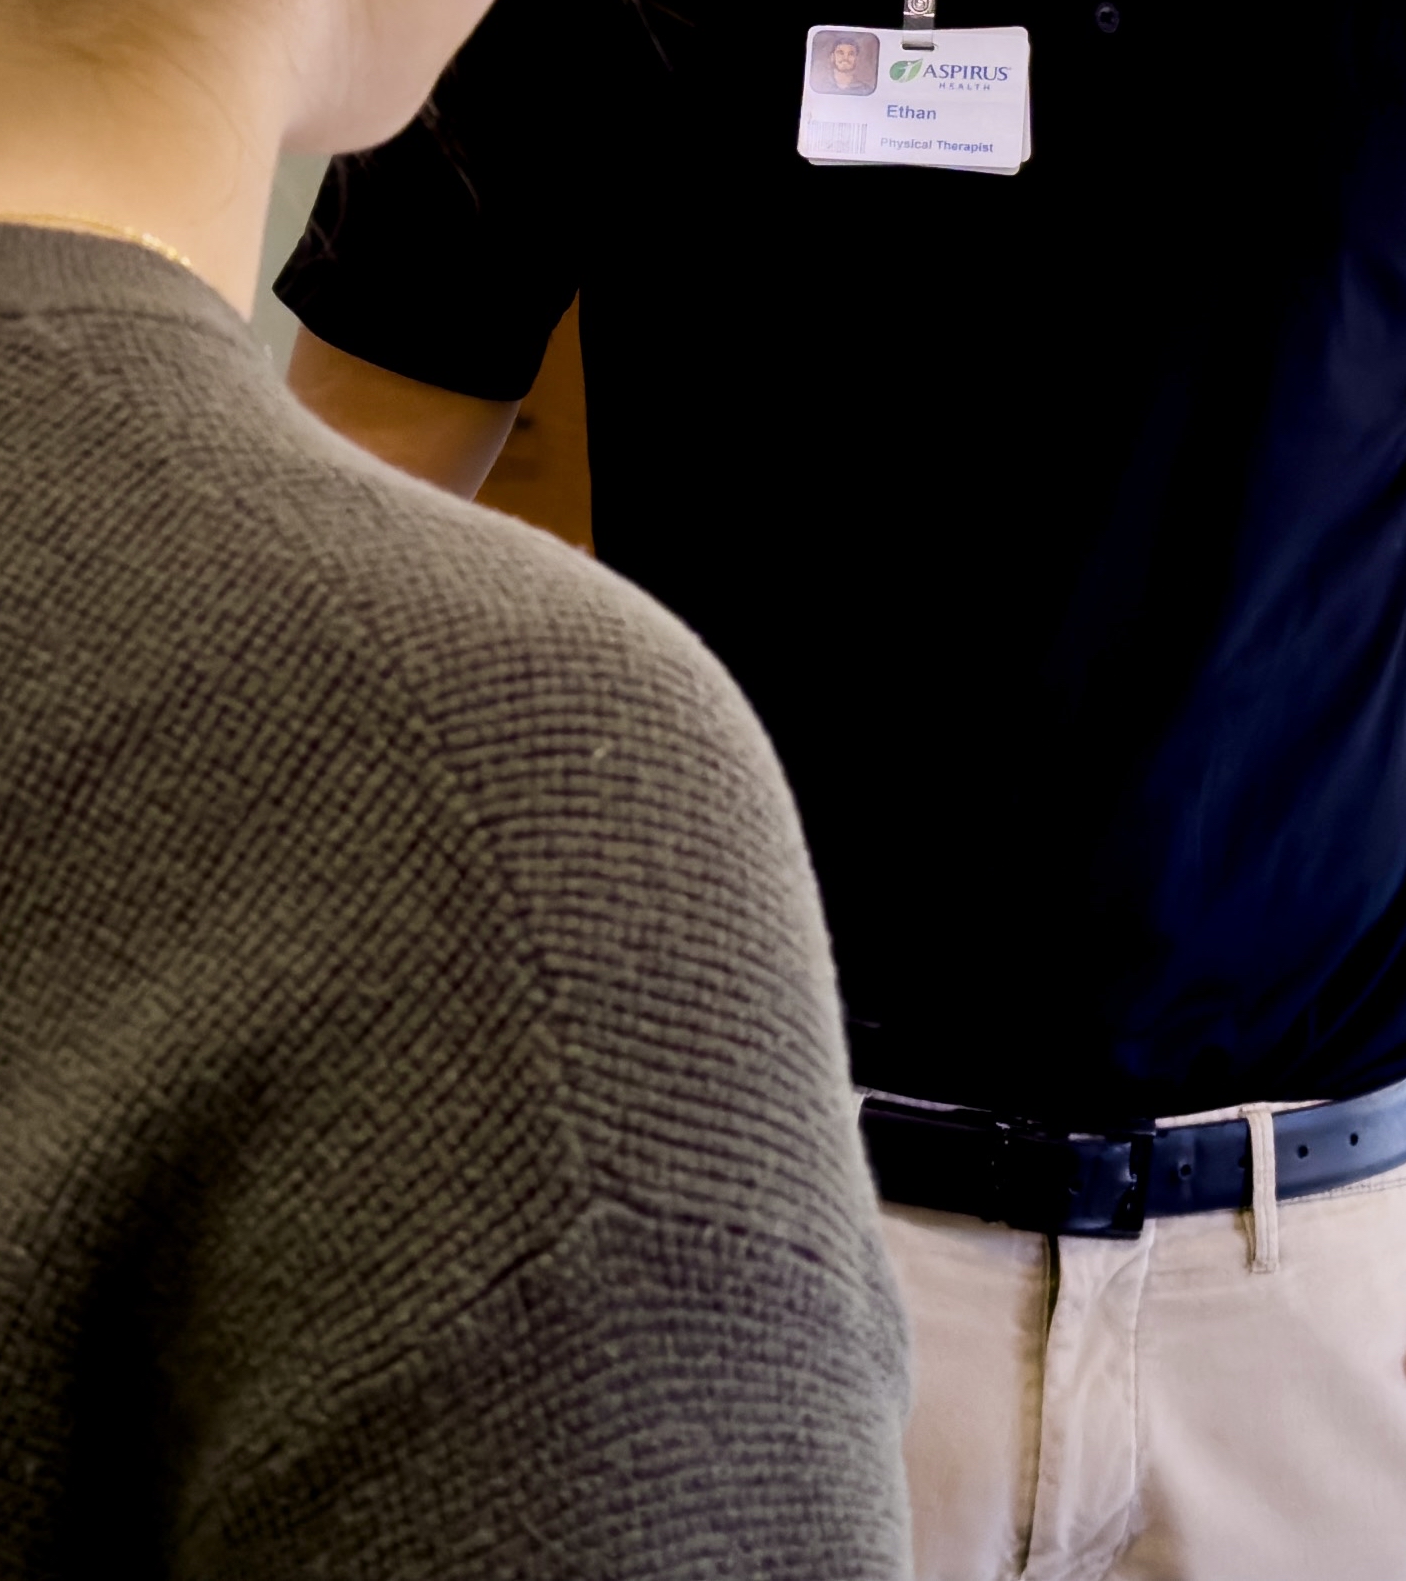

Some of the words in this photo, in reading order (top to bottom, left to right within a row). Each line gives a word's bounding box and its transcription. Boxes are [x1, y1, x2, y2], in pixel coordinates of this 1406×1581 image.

[923, 64, 1009, 82] ASPIRUS
[939, 82, 991, 92] HEALTH
[886, 104, 937, 120] Ethan
[880, 137, 932, 151] Physical
[937, 140, 994, 154] Therapist
